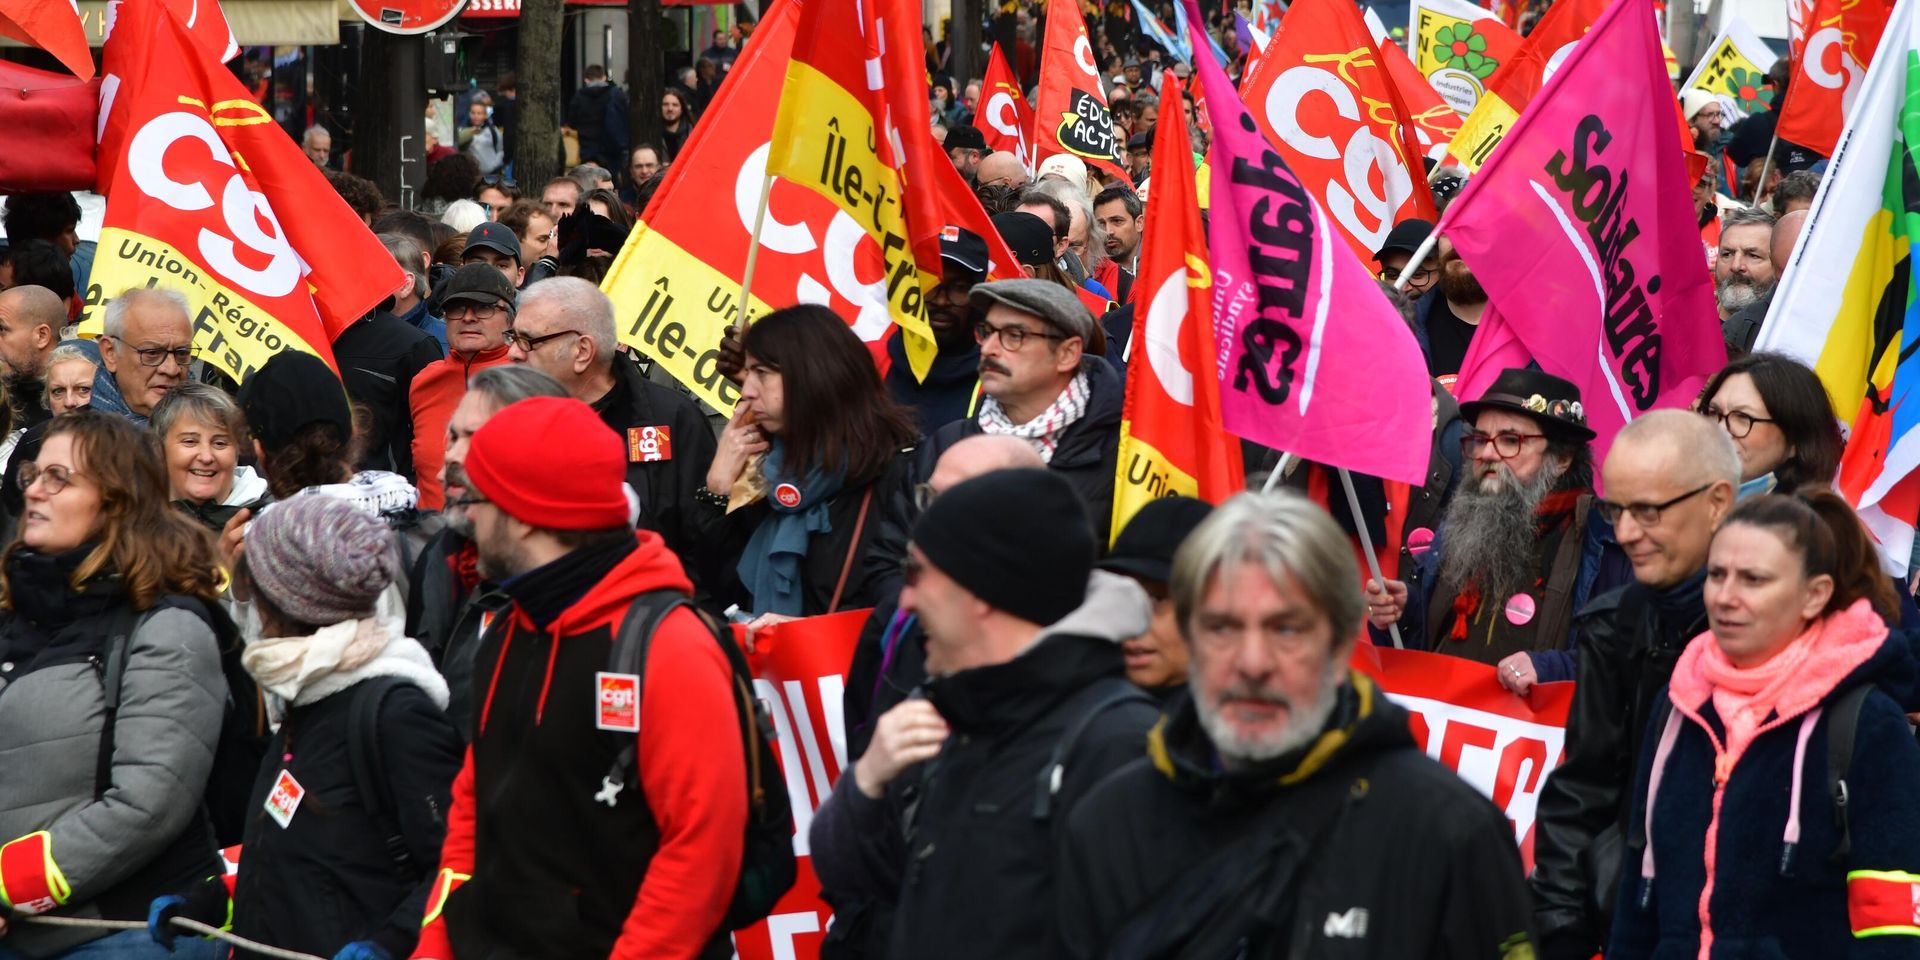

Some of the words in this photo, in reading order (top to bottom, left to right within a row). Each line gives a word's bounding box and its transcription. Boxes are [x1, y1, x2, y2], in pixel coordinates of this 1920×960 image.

[1418, 13, 1432, 79] FNI
[1696, 45, 1737, 93] FNI
[1265, 65, 1414, 254] cg
[128, 111, 303, 297] cg
[639, 426, 662, 462] cgt
[601, 687, 634, 708] cgt
